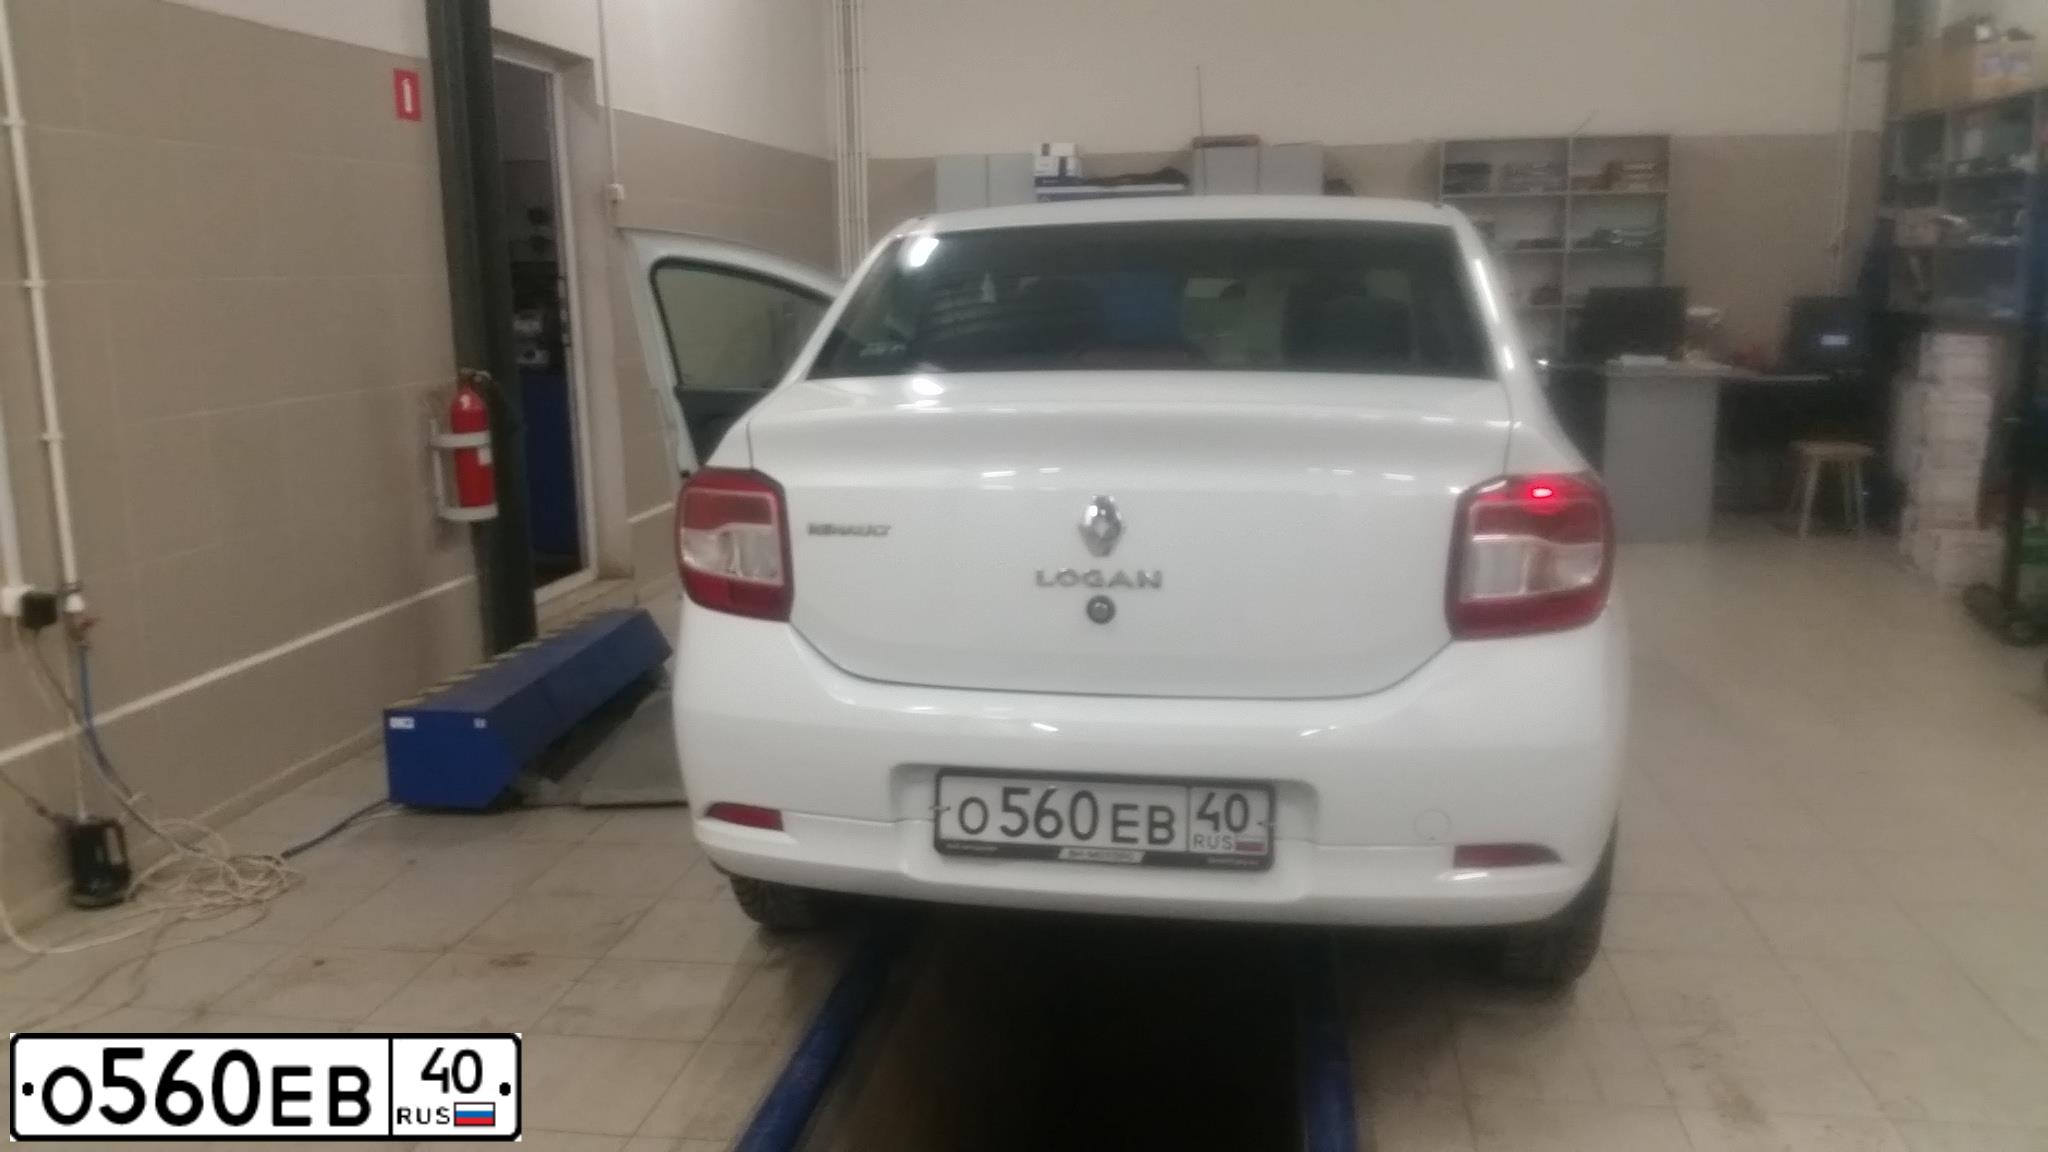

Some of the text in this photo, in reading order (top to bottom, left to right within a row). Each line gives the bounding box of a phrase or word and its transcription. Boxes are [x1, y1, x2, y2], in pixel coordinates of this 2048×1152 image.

[1034, 568, 1163, 589] LOGAN
[1196, 791, 1250, 833] 40
[1193, 833, 1233, 850] RUS
